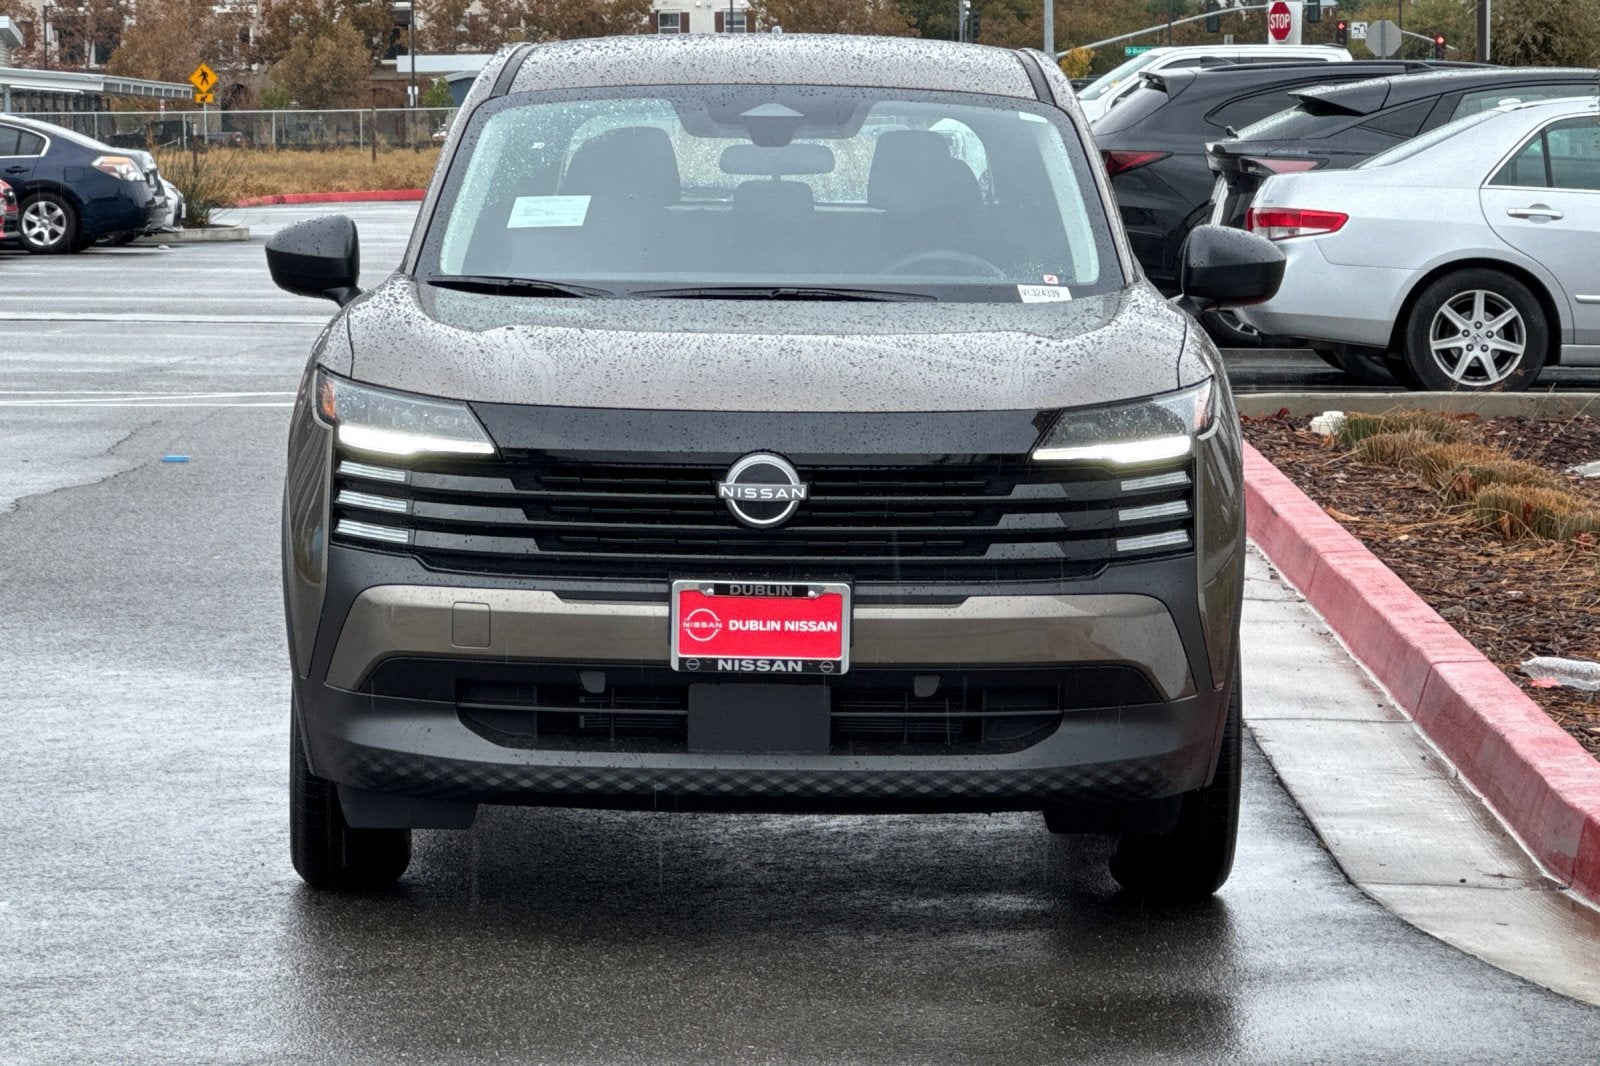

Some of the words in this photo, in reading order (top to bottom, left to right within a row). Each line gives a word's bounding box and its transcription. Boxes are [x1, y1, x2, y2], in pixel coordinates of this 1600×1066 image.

[1270, 13, 1290, 29] STOP
[720, 485, 805, 499] NISSAN
[729, 584, 793, 596] DUBLIN
[682, 621, 723, 629] NISSAN
[728, 619, 781, 631] DUBLIN
[784, 620, 838, 632] NISSAN
[717, 659, 803, 672] NISSAN
